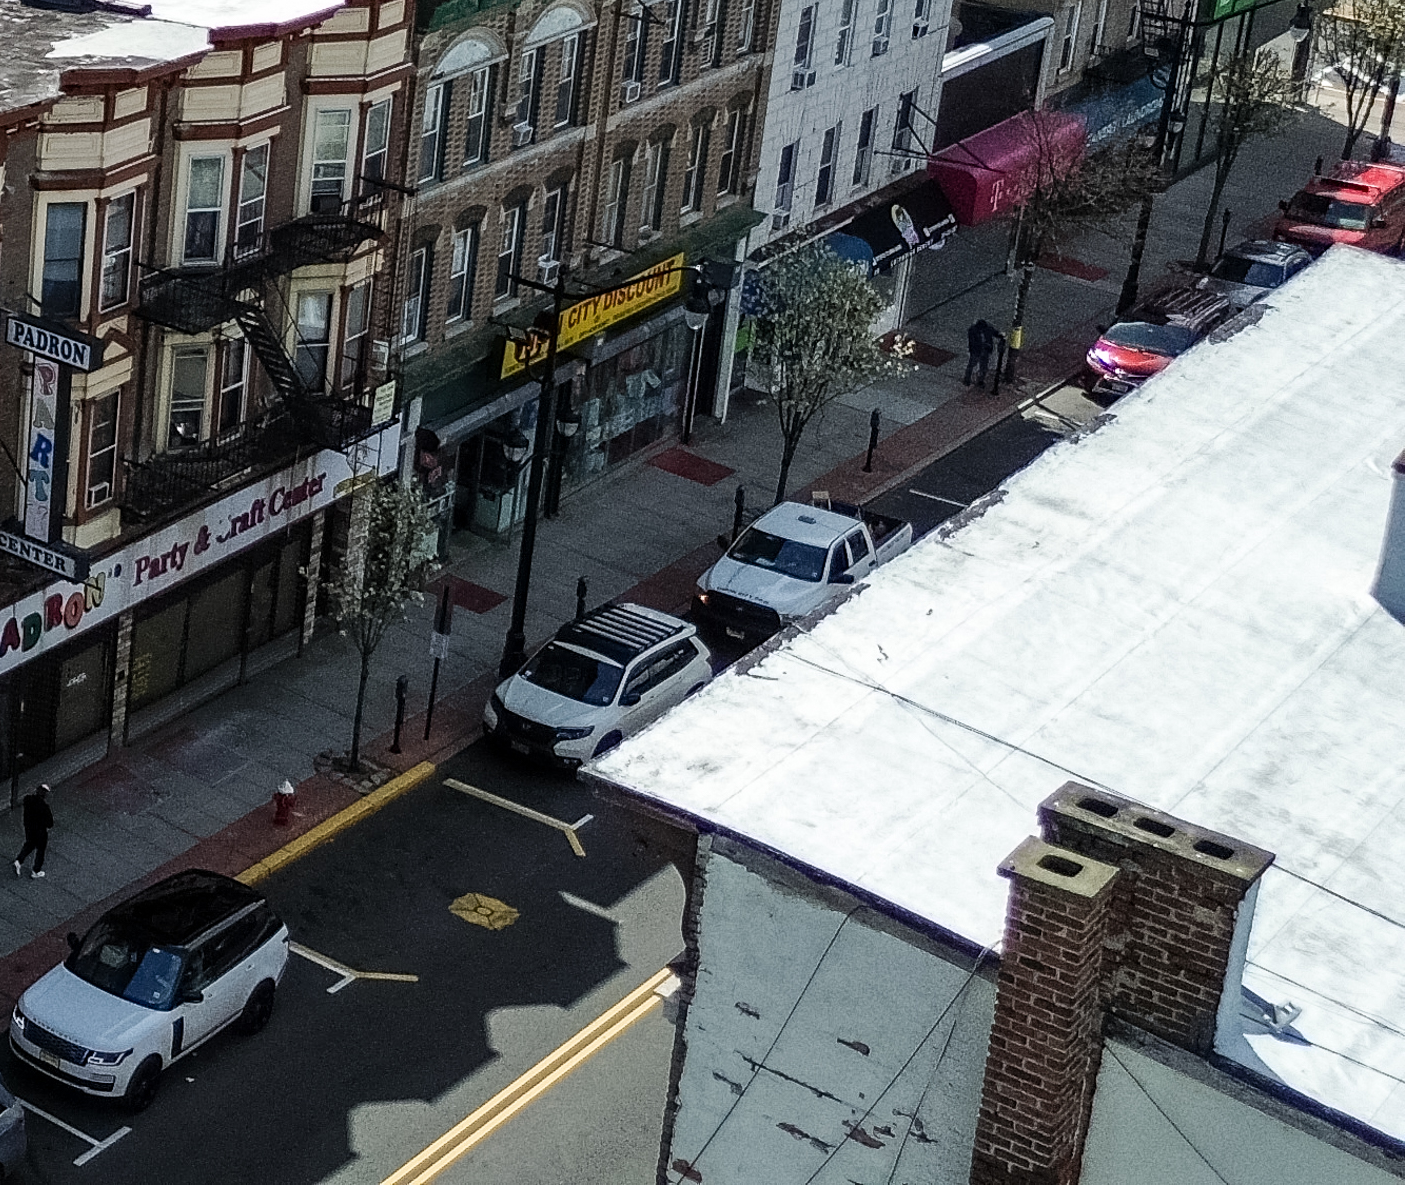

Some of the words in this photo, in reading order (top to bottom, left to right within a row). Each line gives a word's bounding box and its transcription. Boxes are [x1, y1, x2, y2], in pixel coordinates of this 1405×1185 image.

[568, 294, 601, 329] CITY
[603, 260, 675, 311] DISCOUNT
[13, 322, 87, 365] PADRON
[28, 363, 57, 522] PART
[133, 541, 190, 587] Party
[194, 525, 211, 555] &
[268, 472, 326, 516] Center
